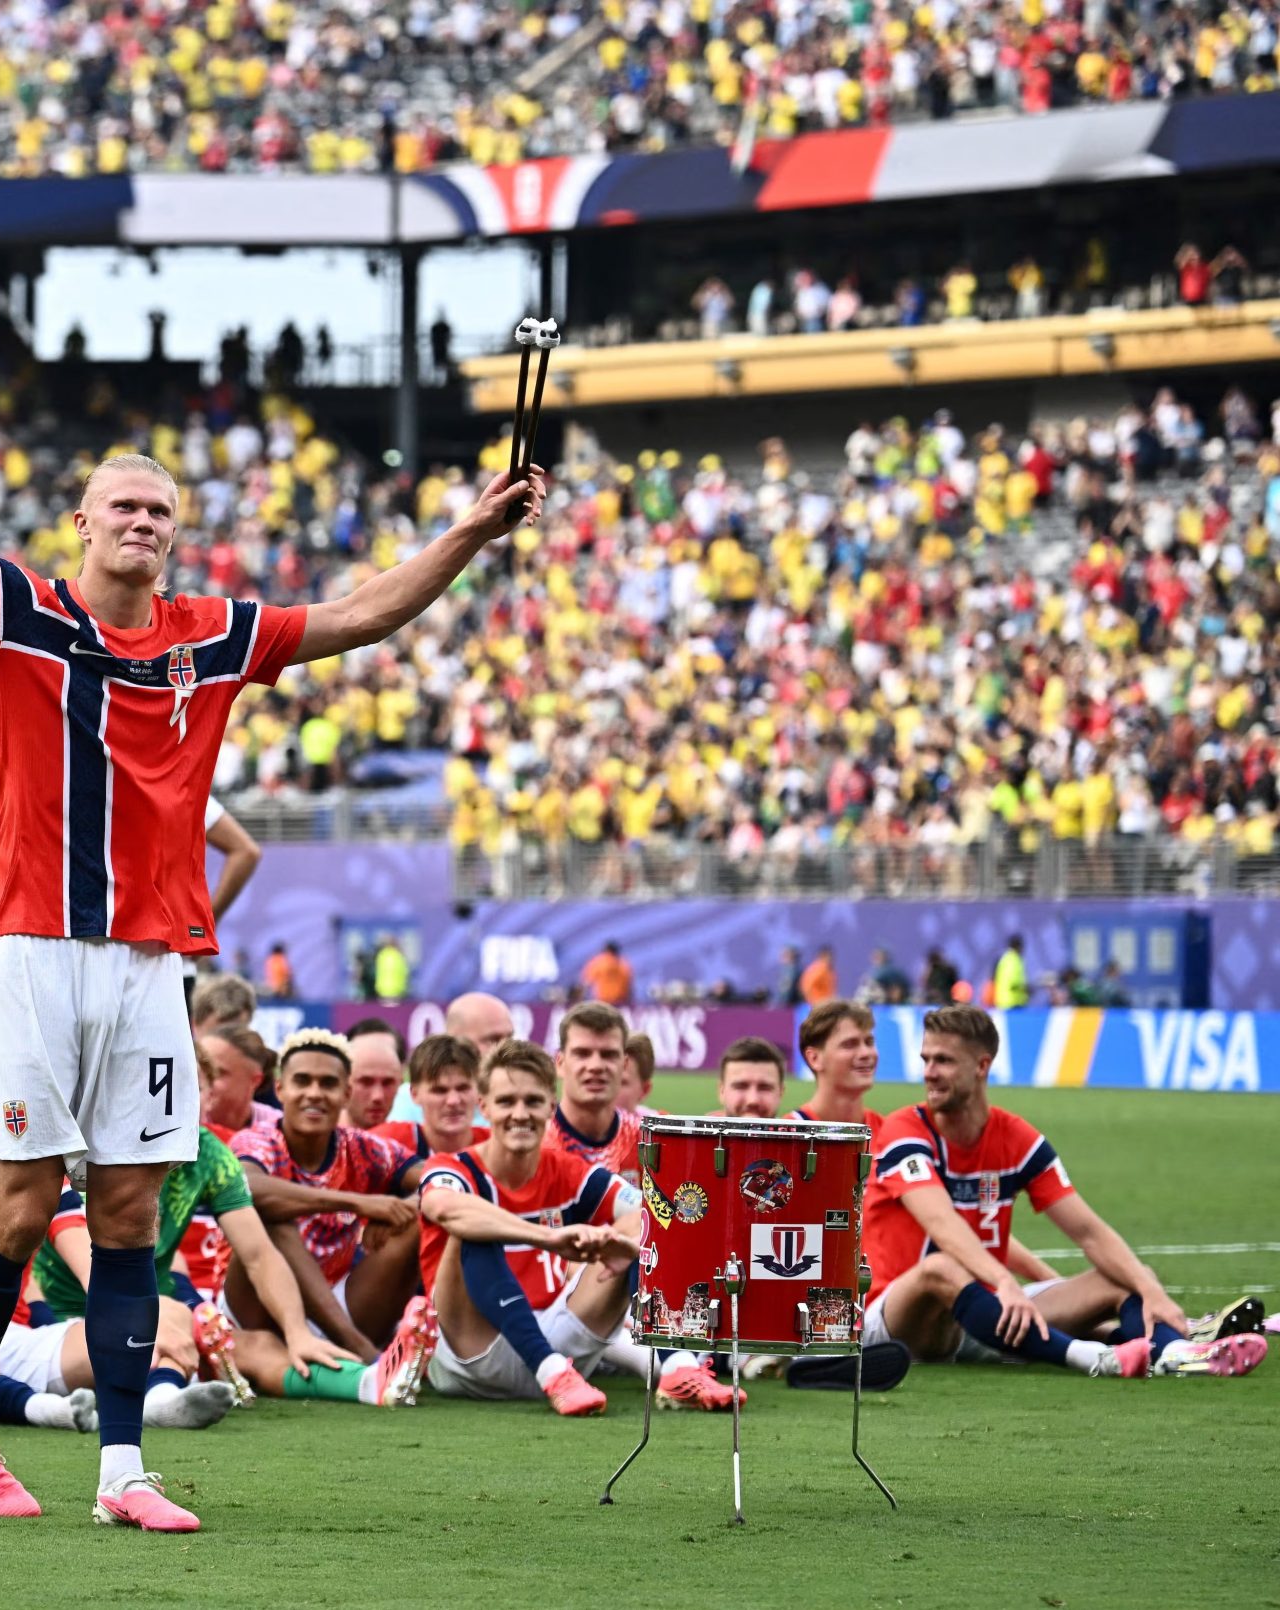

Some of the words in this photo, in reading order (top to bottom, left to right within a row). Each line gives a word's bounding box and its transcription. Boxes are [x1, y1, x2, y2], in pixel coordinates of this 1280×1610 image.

[169, 689, 195, 745] 9
[481, 934, 559, 983] FIFA
[1129, 1010, 1261, 1091] VISA
[149, 1057, 173, 1116] 9
[979, 1204, 1000, 1248] 3
